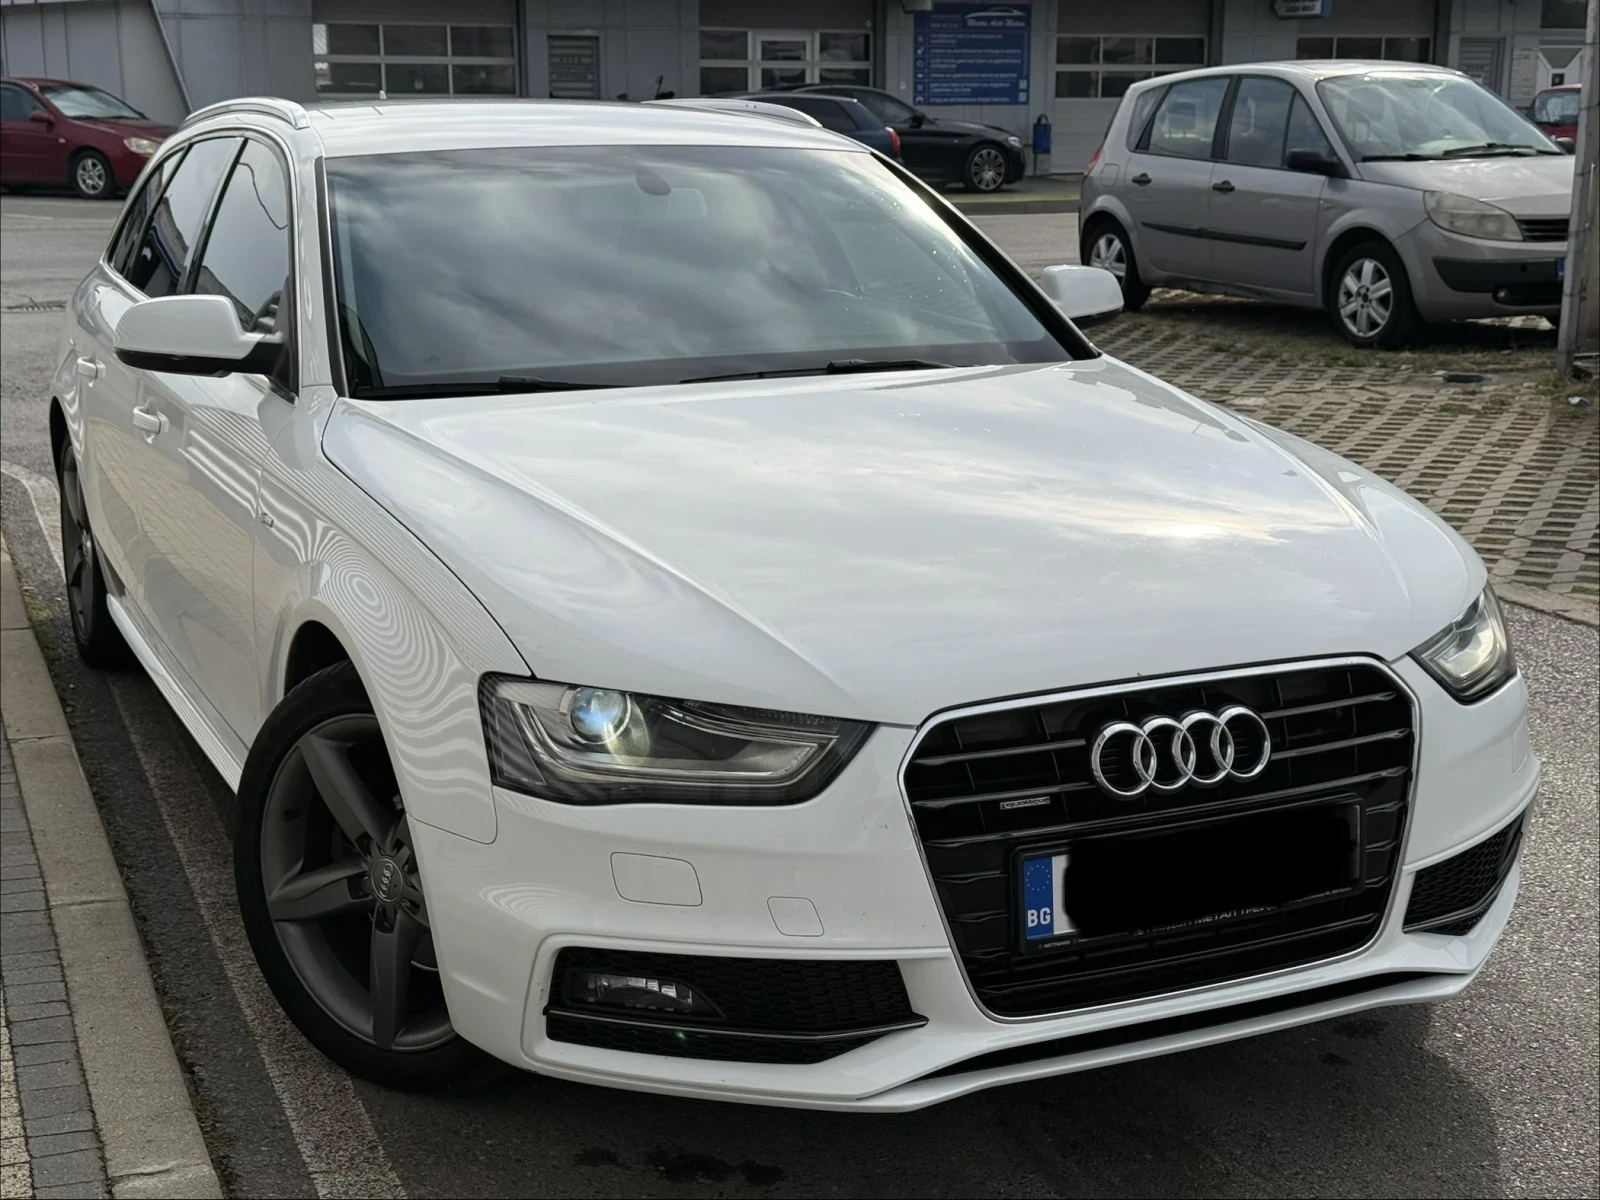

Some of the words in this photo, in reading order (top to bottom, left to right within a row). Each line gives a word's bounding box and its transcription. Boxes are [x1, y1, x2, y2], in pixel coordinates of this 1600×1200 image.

[1005, 796, 1050, 809] quattro
[1027, 907, 1051, 928] BG
[1194, 909, 1237, 925] МЕТАЛ
